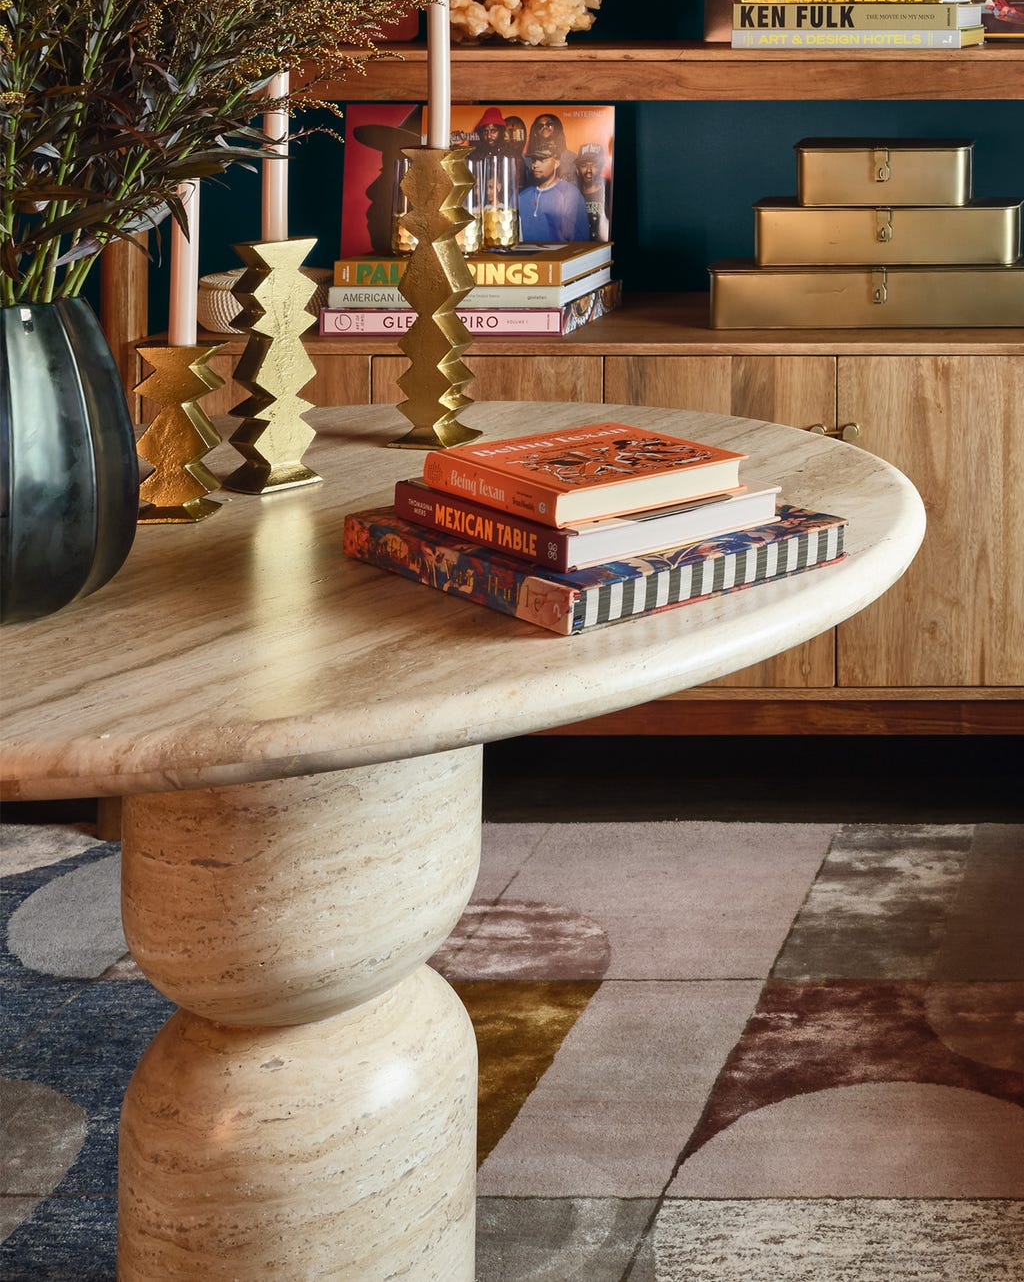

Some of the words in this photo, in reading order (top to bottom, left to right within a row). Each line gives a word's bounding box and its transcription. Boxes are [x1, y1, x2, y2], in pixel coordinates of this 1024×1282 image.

[740, 5, 786, 28] KEN
[796, 5, 855, 28] FULK
[758, 34, 788, 46] ART
[791, 34, 803, 46] &
[805, 34, 861, 46] DESIGN
[863, 33, 923, 46] HOTELS
[356, 263, 402, 285] PAL
[467, 263, 539, 285] INGS
[342, 293, 395, 303] AMERICAN
[383, 316, 413, 329] GLE
[460, 316, 499, 329] PIRO
[472, 440, 555, 457] Being
[550, 428, 630, 443] Texan
[450, 469, 477, 496] Being
[479, 478, 506, 502] Texan
[408, 498, 433, 511] THOMASINA
[434, 503, 493, 542] MEXICAN
[496, 522, 538, 557] TABLE
